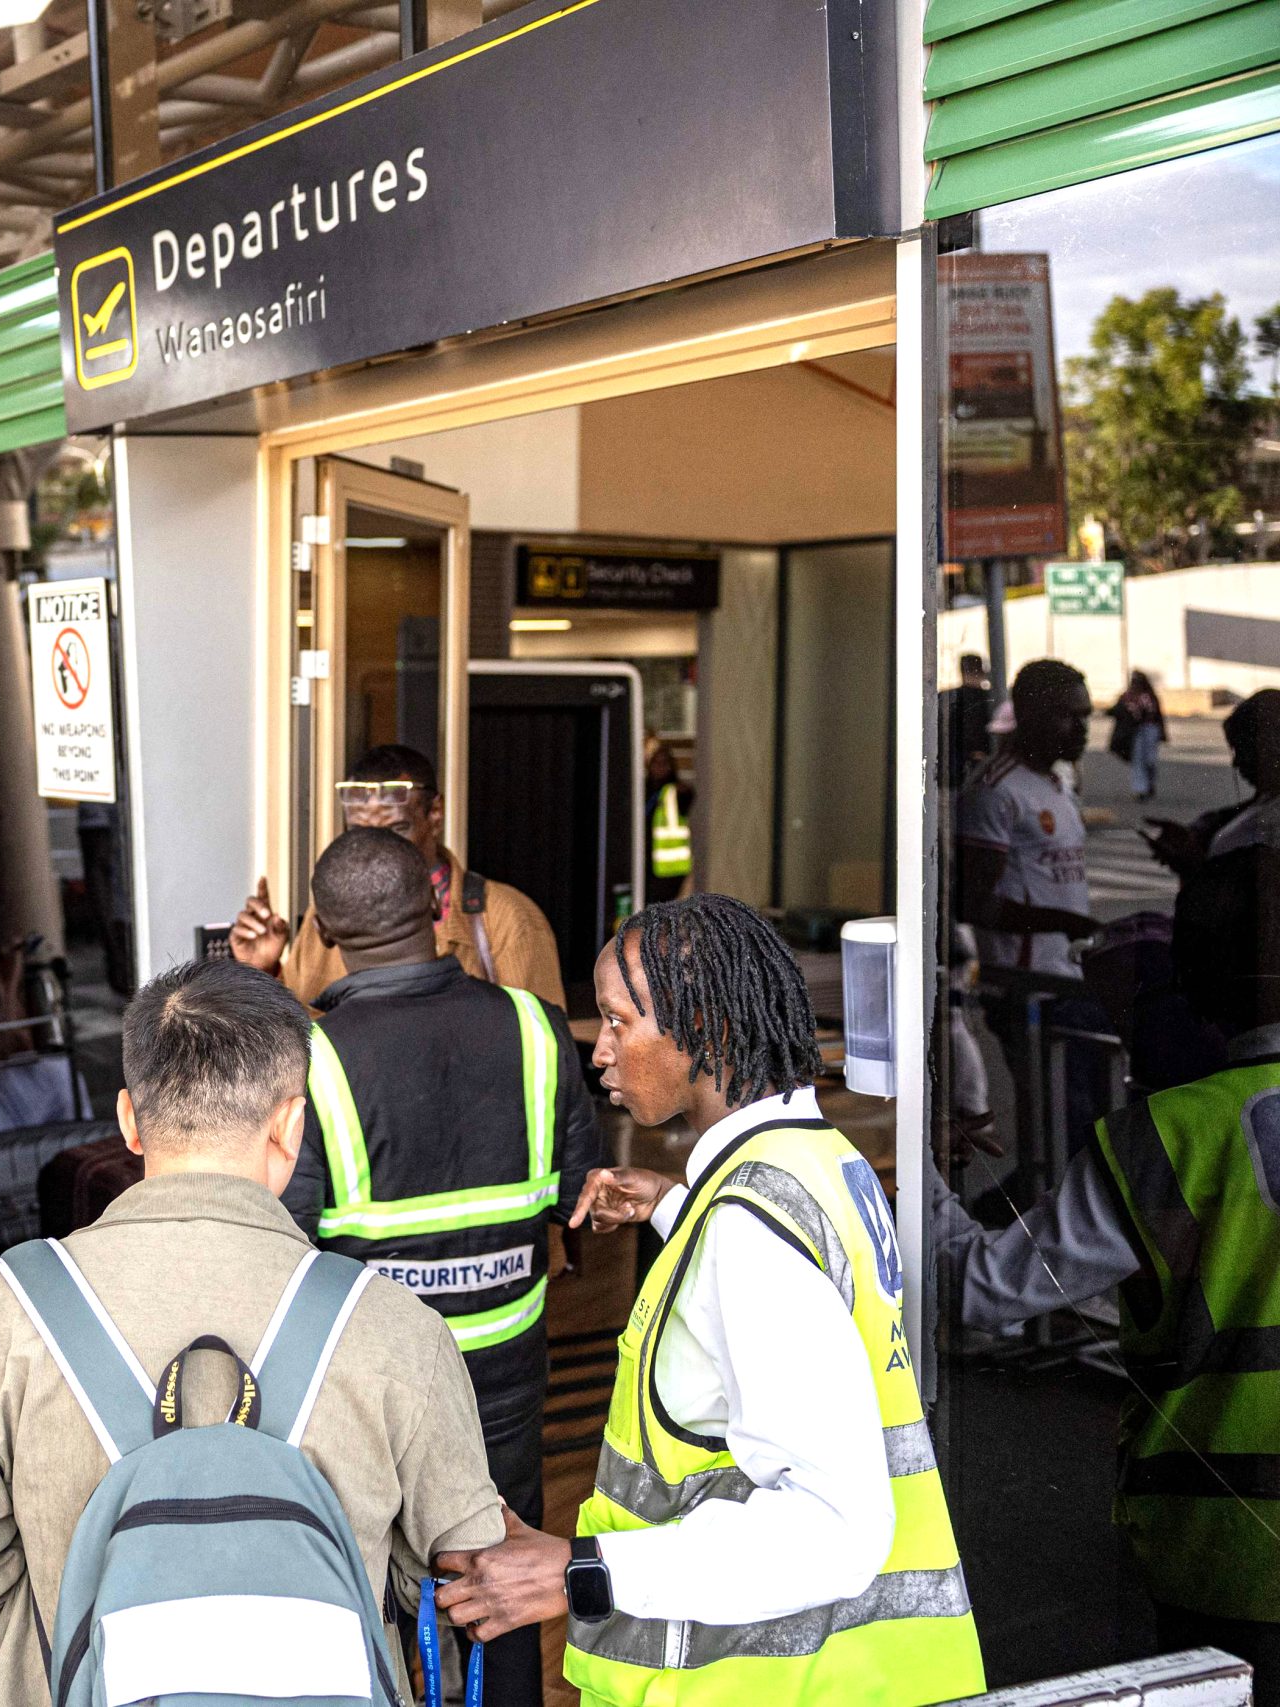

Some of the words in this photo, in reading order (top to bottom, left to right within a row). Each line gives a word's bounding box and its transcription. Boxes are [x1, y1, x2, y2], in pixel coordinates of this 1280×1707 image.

[152, 147, 428, 291] Departures
[156, 276, 327, 364] Wanaosafiri
[38, 592, 100, 623] NOTICE
[42, 723, 55, 736] NO
[59, 723, 106, 738] WEAPONS
[57, 745, 92, 759] BEYOND
[53, 767, 71, 781] THIS
[74, 769, 100, 783] POINT
[160, 1361, 179, 1424] ellesse
